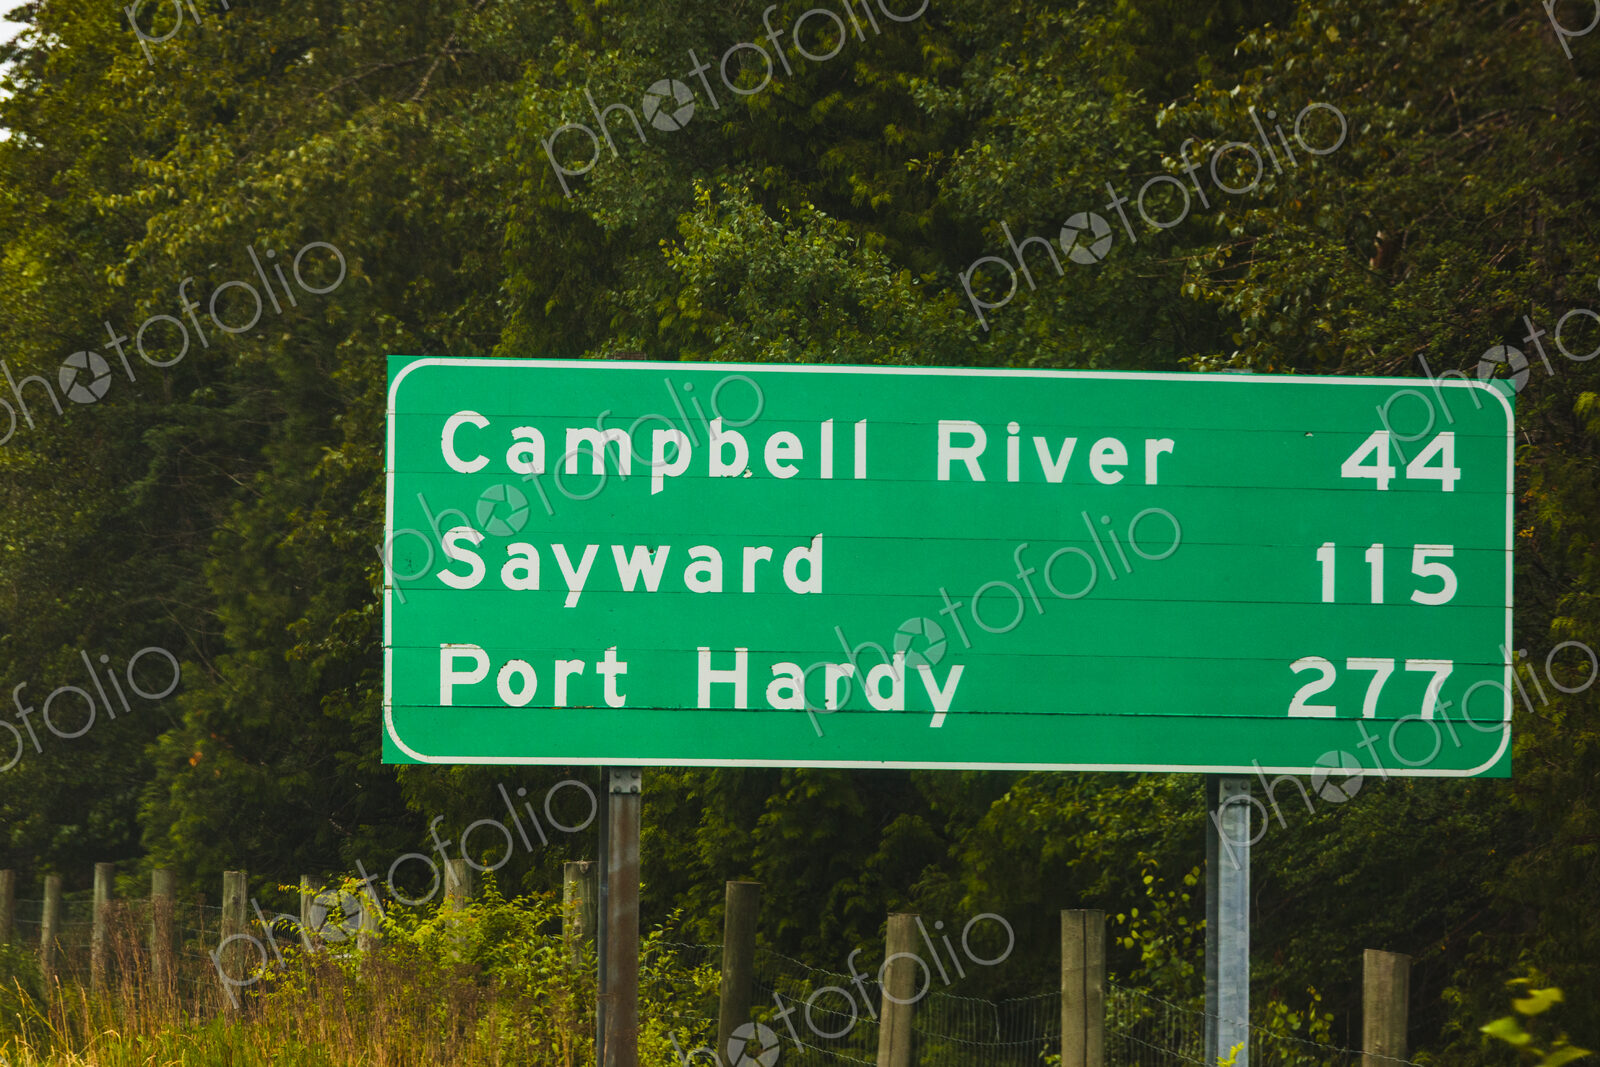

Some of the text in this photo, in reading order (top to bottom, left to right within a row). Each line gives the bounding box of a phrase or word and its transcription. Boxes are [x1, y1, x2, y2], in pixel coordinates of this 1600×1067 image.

[441, 409, 1462, 495] Campbell River 44
[436, 526, 1458, 609] Sayward 115
[439, 643, 1454, 729] Port Hardy 277
